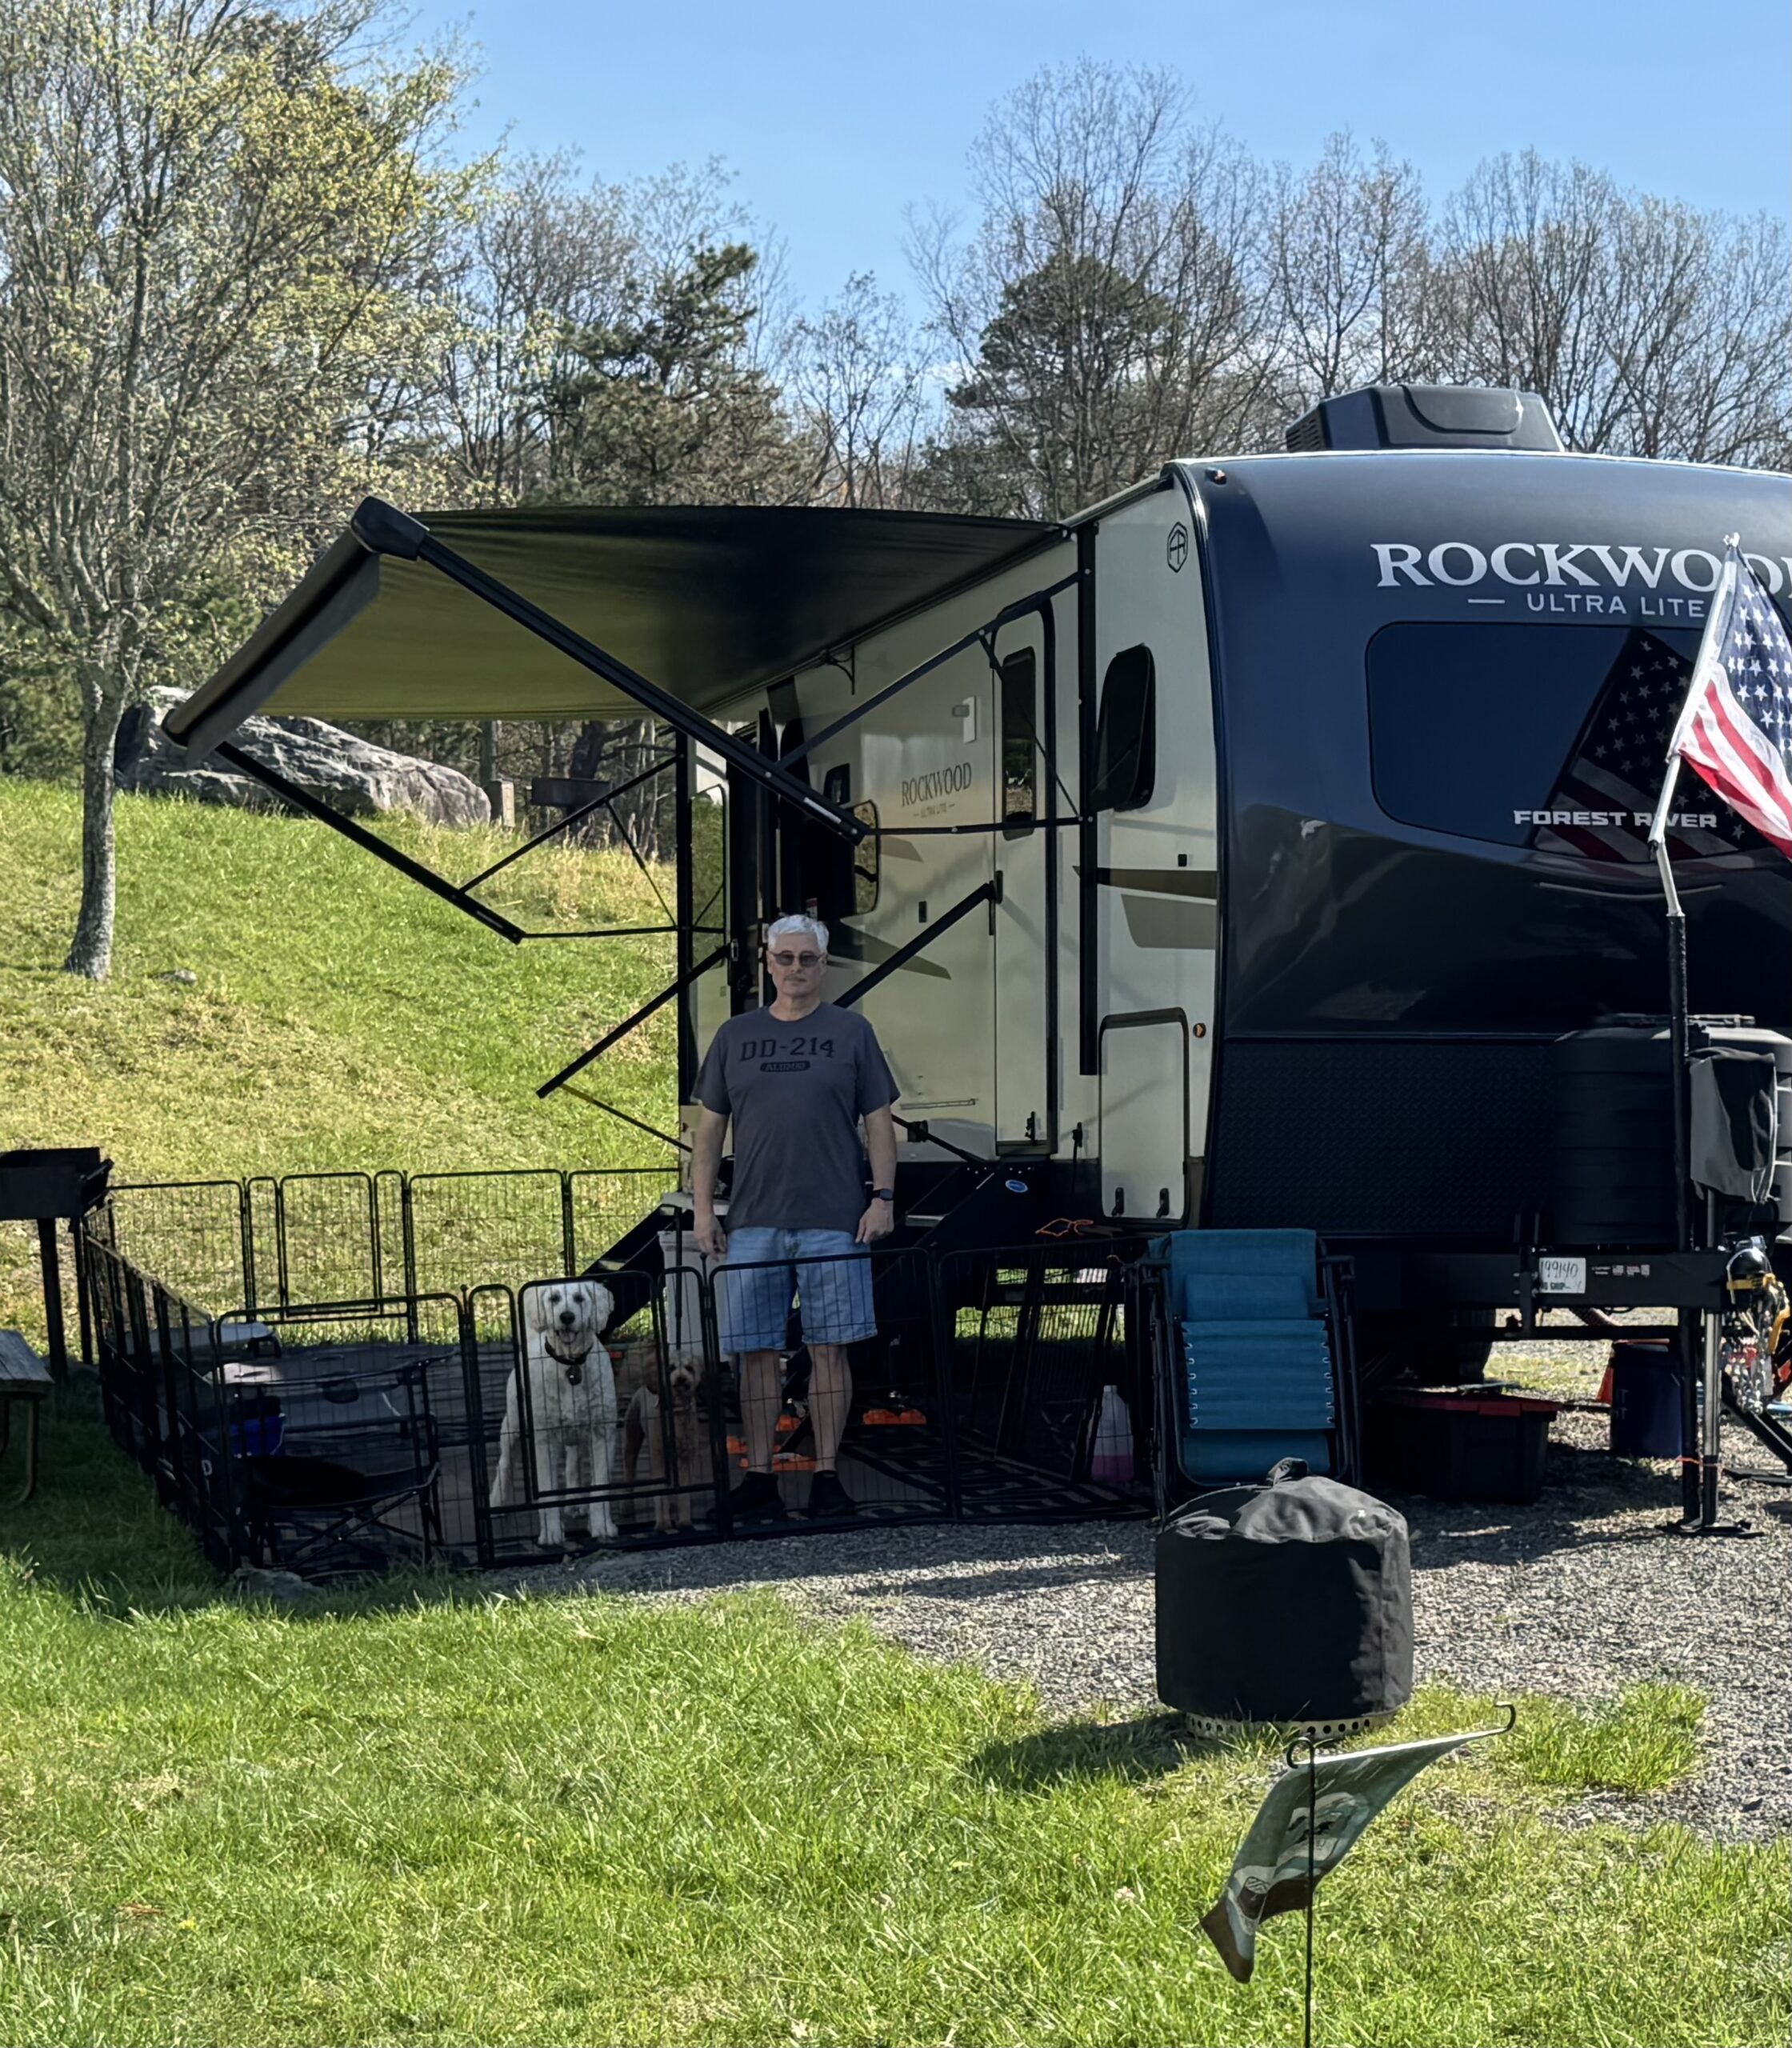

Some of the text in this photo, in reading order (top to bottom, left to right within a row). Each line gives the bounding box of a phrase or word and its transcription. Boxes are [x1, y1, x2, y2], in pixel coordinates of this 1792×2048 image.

[1370, 542, 1792, 599] ROCKWOO
[1527, 593, 1705, 618] ULTRA LITE
[901, 762, 972, 807] ROCKWOOD
[1514, 810, 1718, 828] FOREST RVER
[740, 1037, 836, 1062] DD-214
